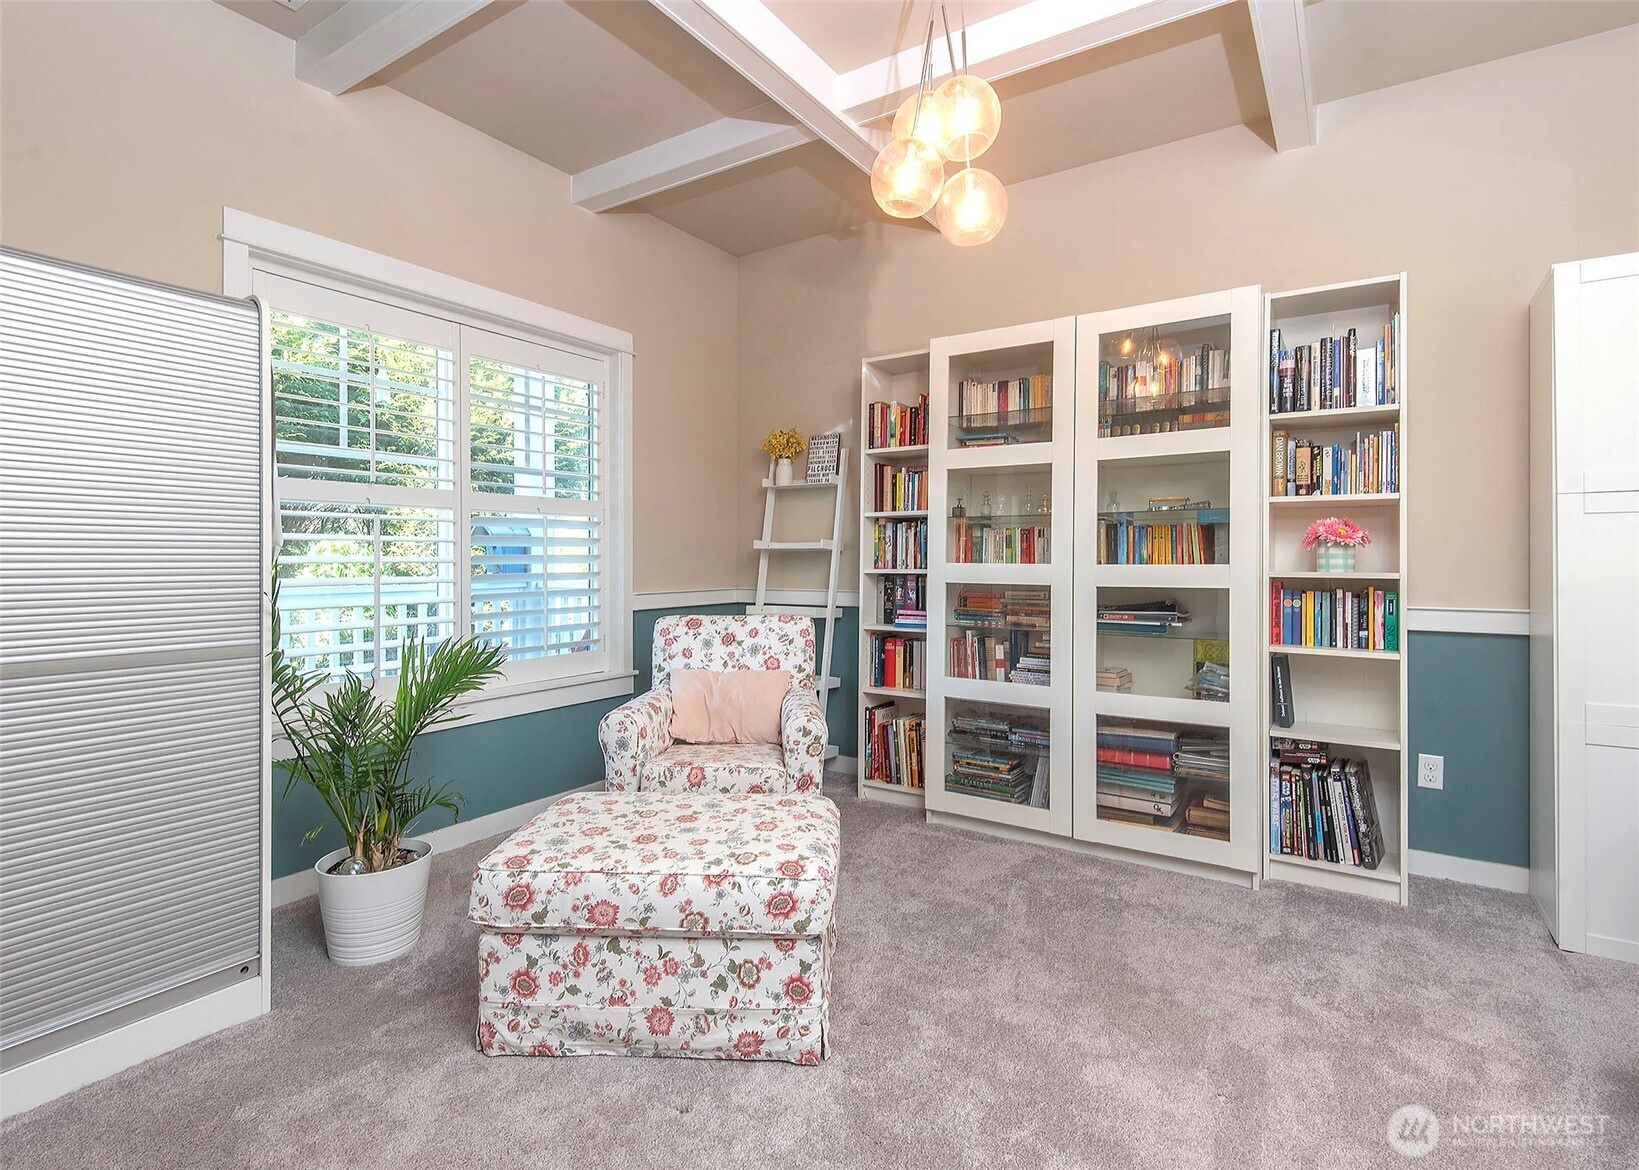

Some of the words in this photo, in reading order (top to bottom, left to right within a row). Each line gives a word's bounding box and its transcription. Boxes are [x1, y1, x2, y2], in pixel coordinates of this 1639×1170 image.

[1276, 437, 1284, 451] DAN
[807, 464, 836, 473] PILCHUCK
[1276, 452, 1284, 476] BROWN
